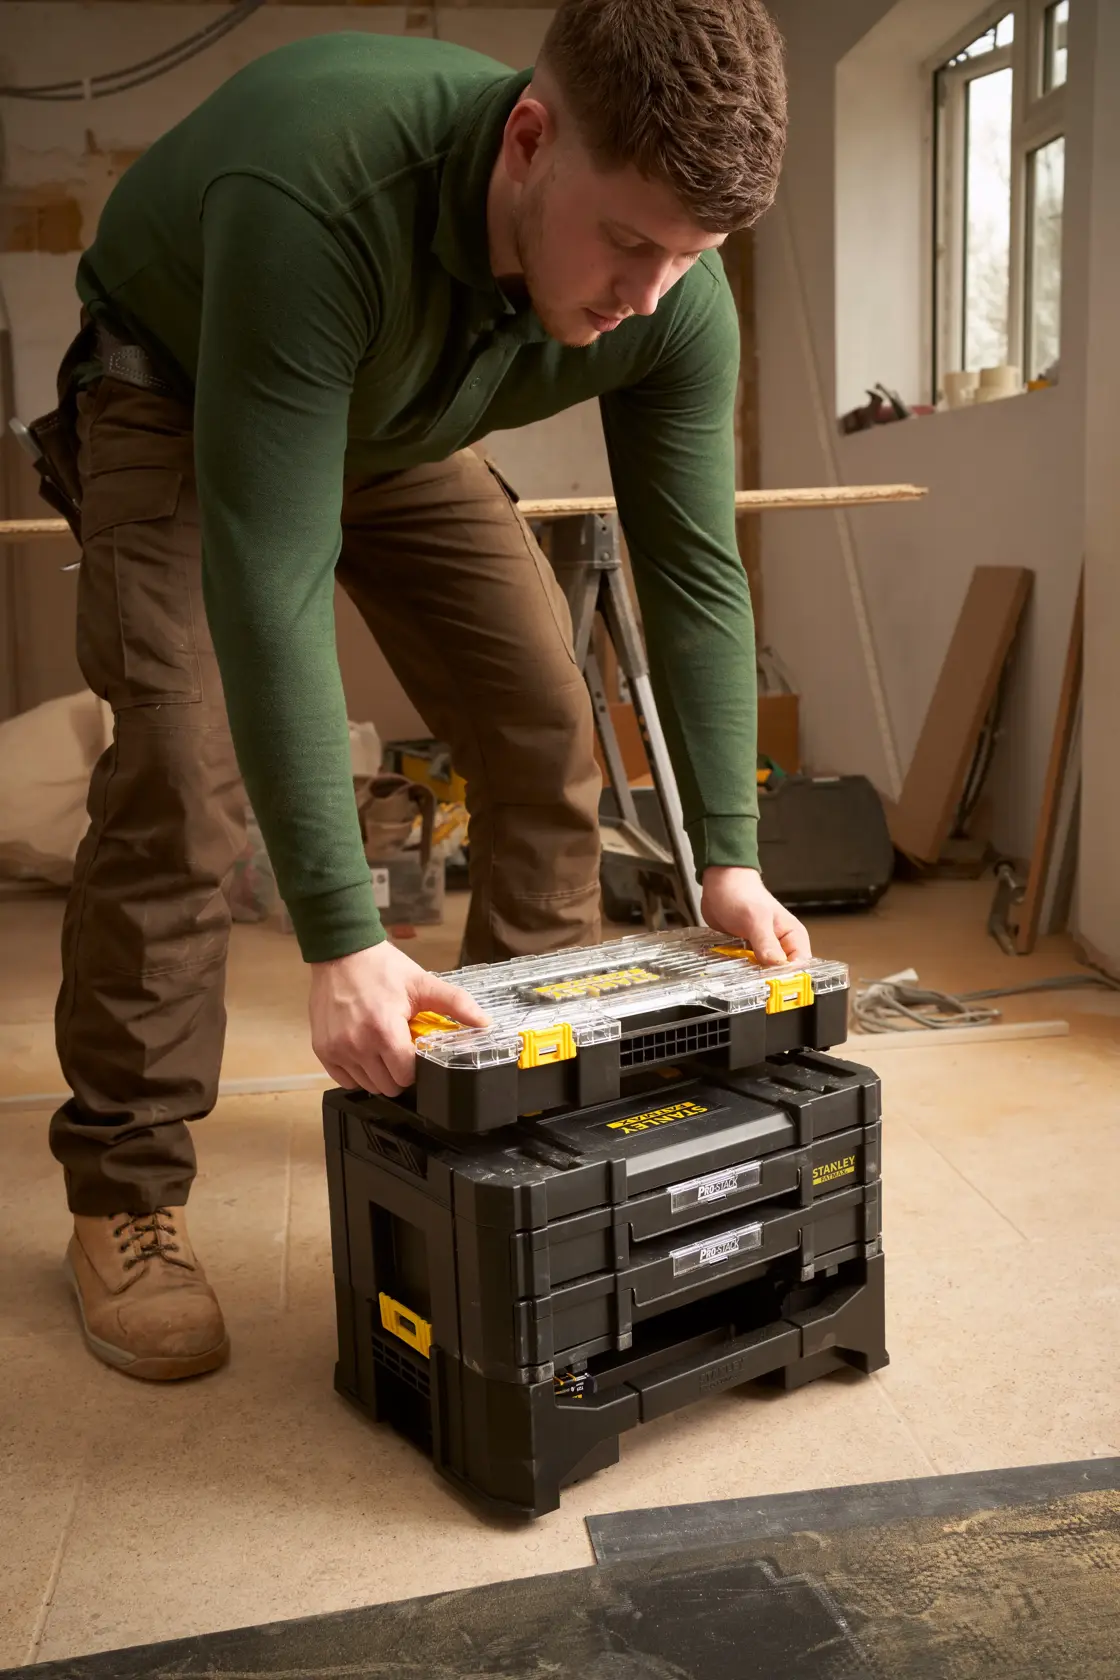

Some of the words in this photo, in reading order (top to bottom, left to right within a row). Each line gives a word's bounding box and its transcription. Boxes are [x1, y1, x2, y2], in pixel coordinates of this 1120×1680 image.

[620, 1106, 708, 1134] STANLEY
[812, 1154, 856, 1179] STANLEY
[698, 1177, 738, 1200] PRO-STACK
[700, 1239, 740, 1262] PRO-STACK
